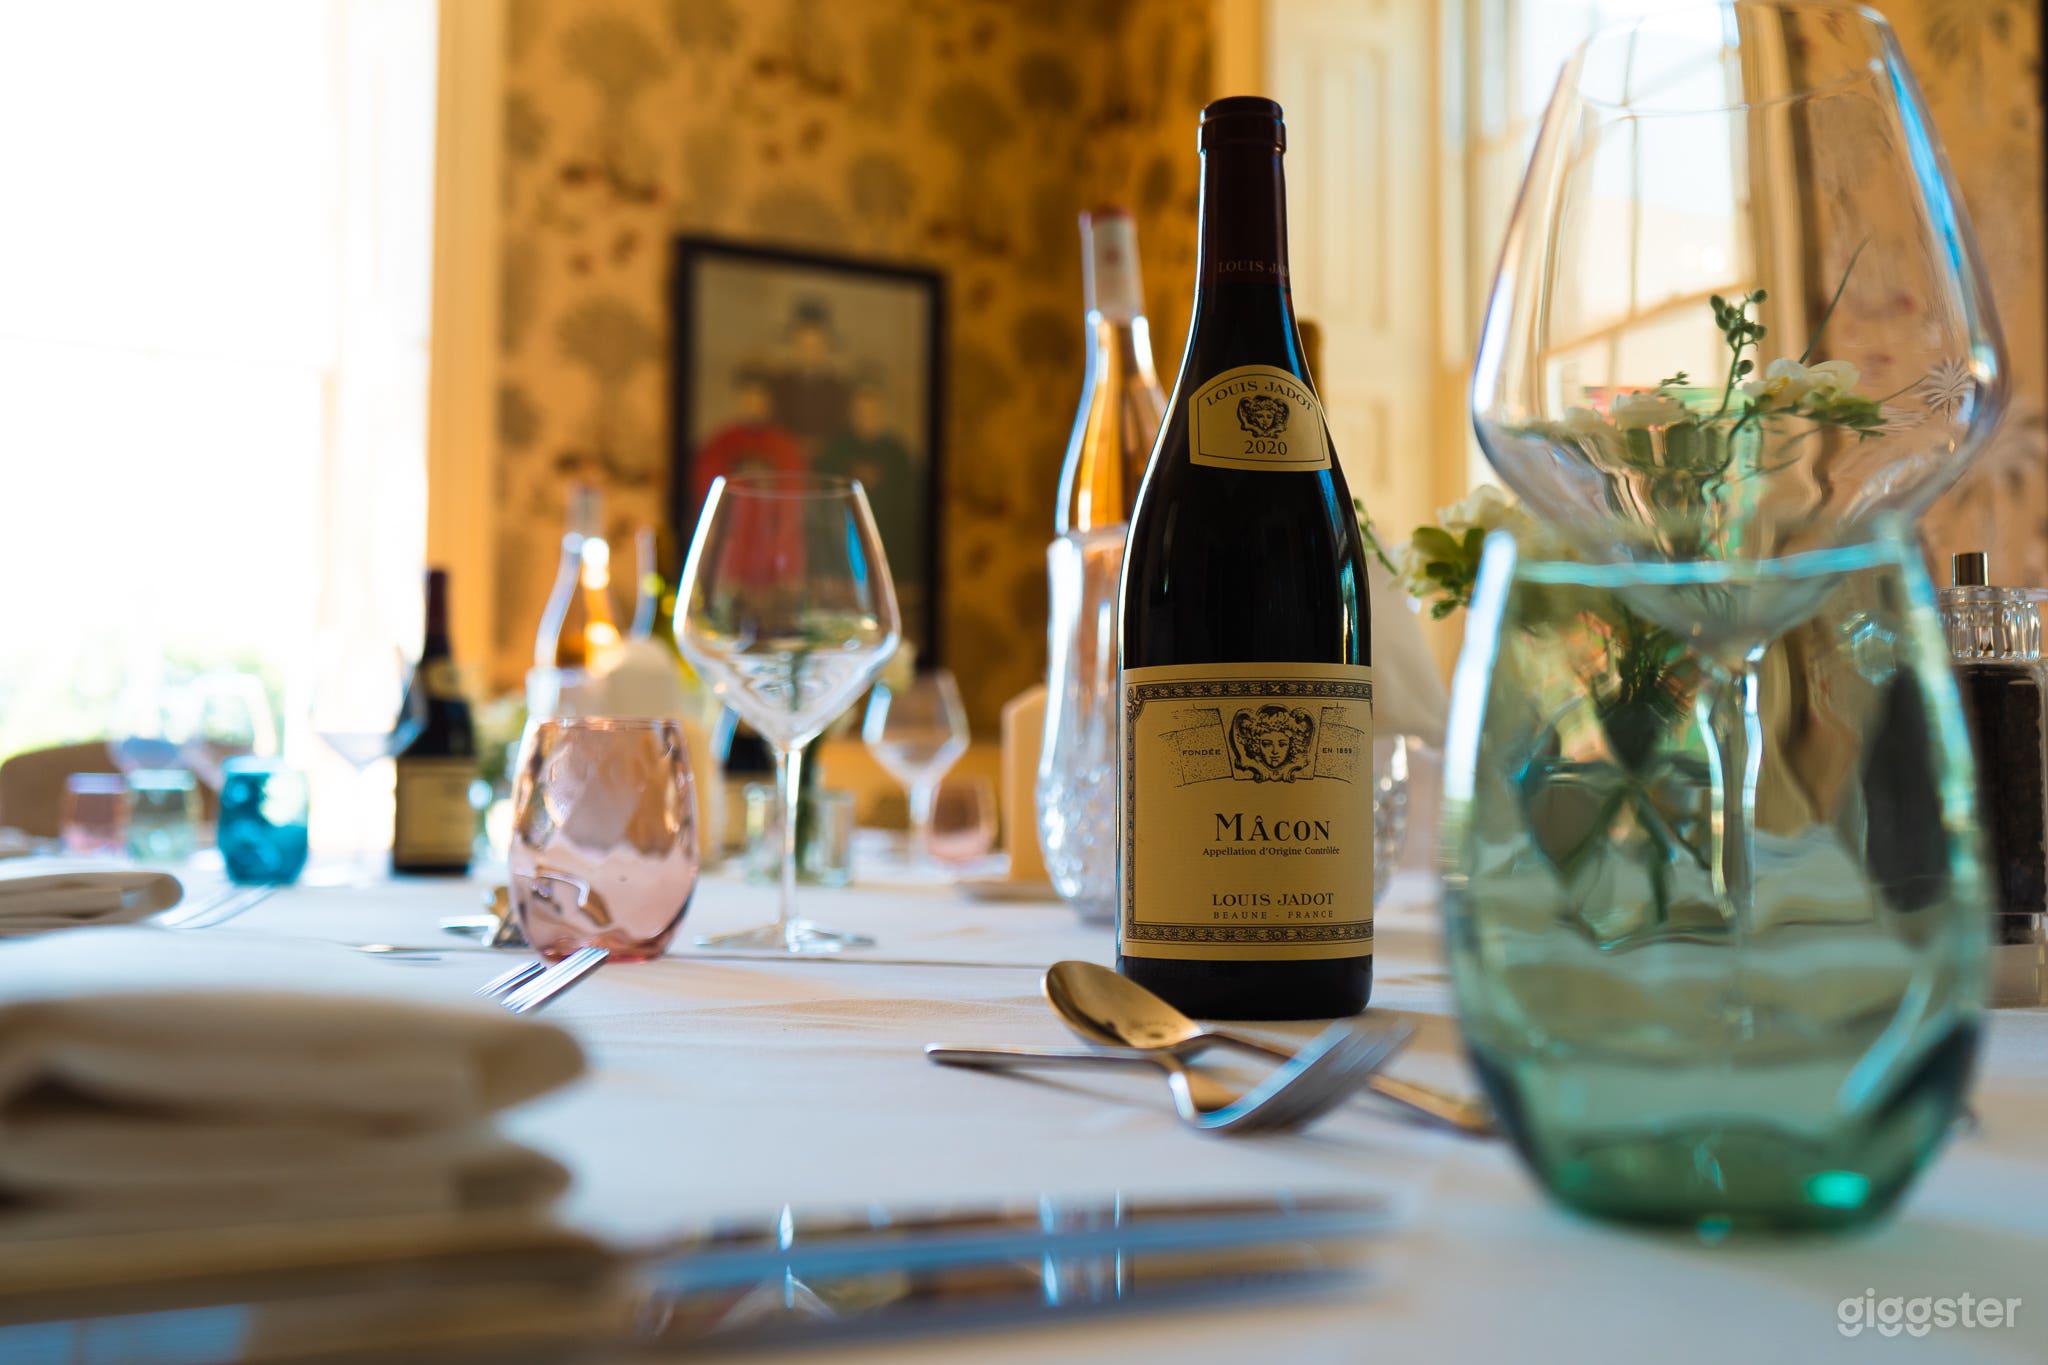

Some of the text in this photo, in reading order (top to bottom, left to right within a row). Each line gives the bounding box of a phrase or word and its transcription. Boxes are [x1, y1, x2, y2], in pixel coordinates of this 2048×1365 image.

[1218, 260, 1264, 273] LOUIS
[1207, 381, 1313, 411] LOUIS JADOT
[1244, 440, 1287, 455] 2020
[1182, 747, 1221, 756] FONDÉE
[1203, 846, 1340, 858] Appellation d'Origine Contrôlée
[1212, 893, 1334, 906] LOUIS JADOT
[1213, 911, 1268, 920] BEAUNE
[1288, 910, 1334, 919] FRANCE
